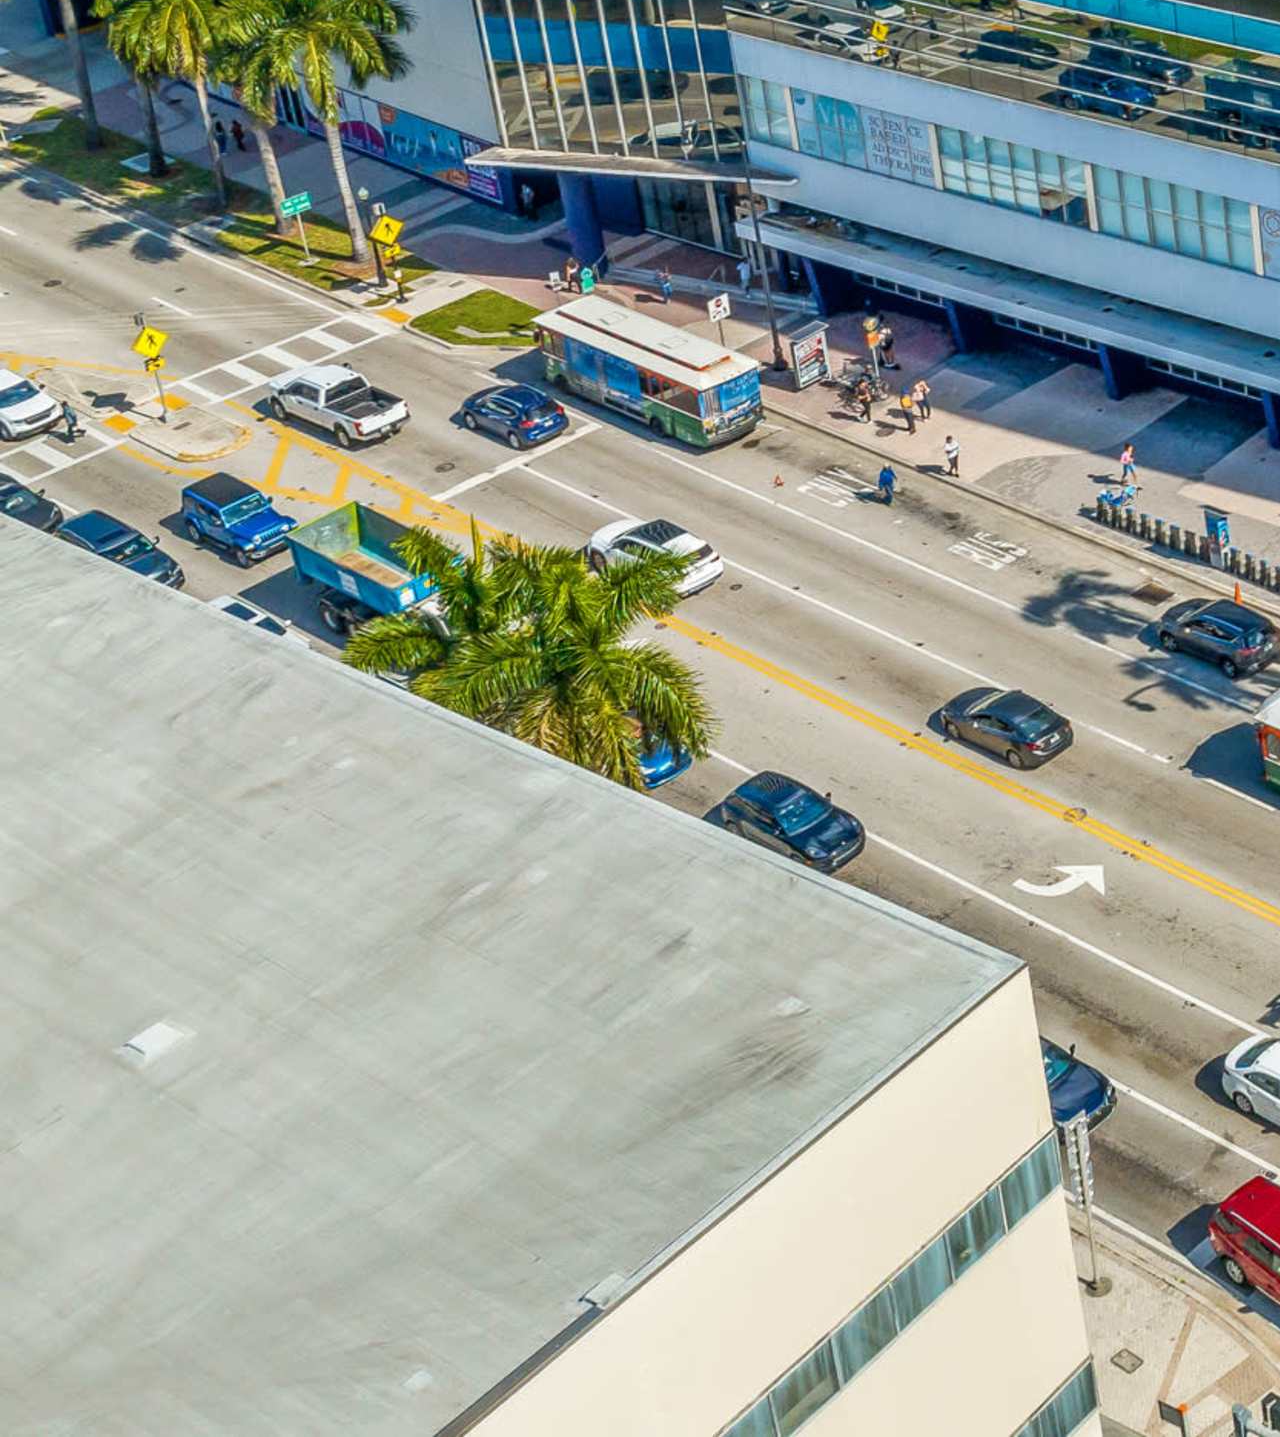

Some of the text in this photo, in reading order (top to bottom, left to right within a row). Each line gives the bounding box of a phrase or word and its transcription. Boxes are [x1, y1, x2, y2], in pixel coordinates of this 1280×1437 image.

[868, 113, 923, 140] SCIENCE
[870, 126, 908, 146] BASED
[946, 531, 1028, 571] BUS
